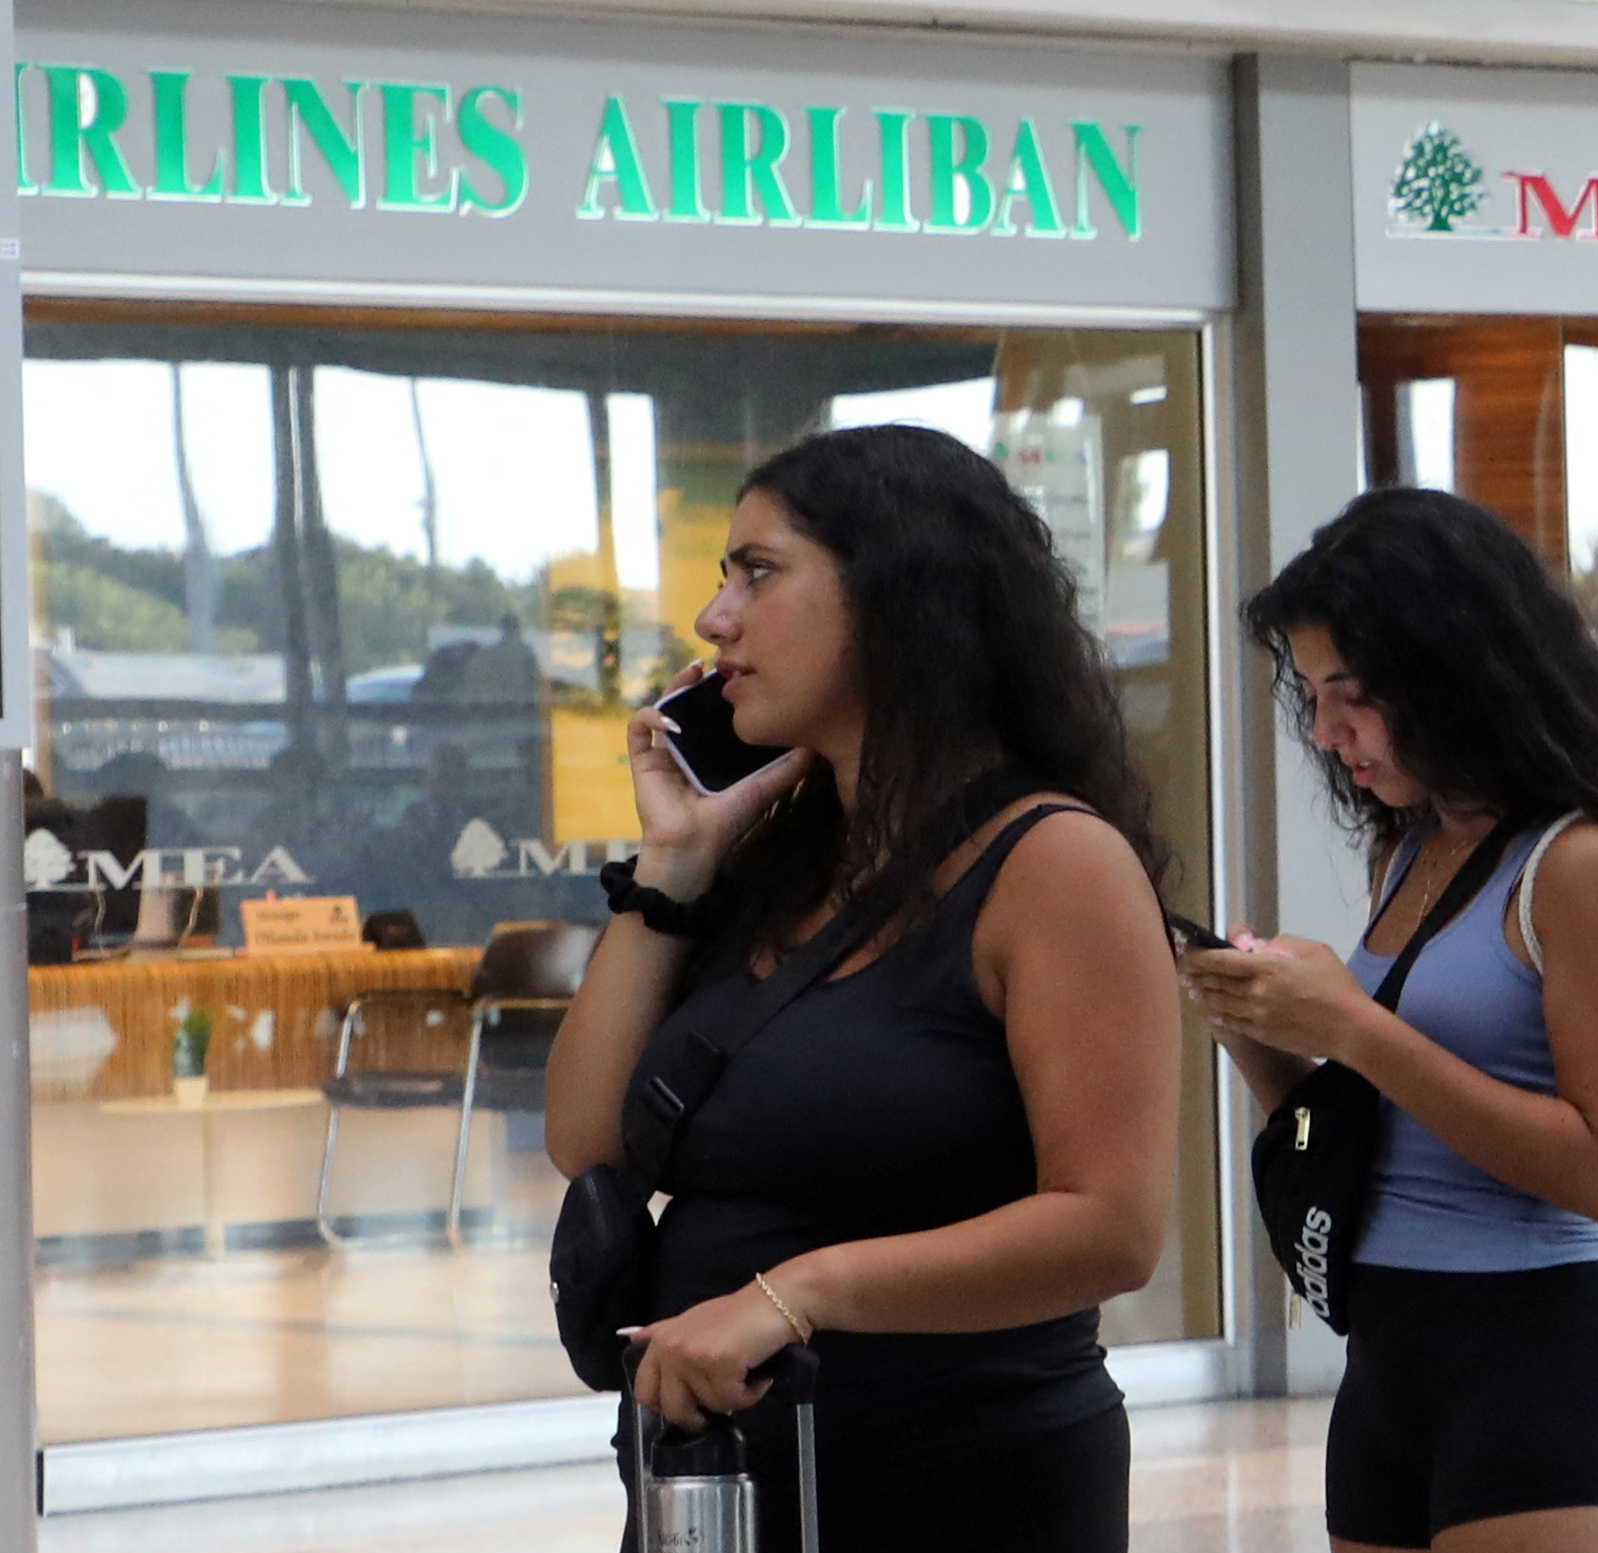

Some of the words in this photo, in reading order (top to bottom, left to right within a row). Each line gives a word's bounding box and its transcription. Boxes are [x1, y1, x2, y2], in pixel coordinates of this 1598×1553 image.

[576, 90, 1142, 241] AIRLIBAN
[77, 845, 316, 890] MEA
[1295, 1206, 1332, 1319] adidas
